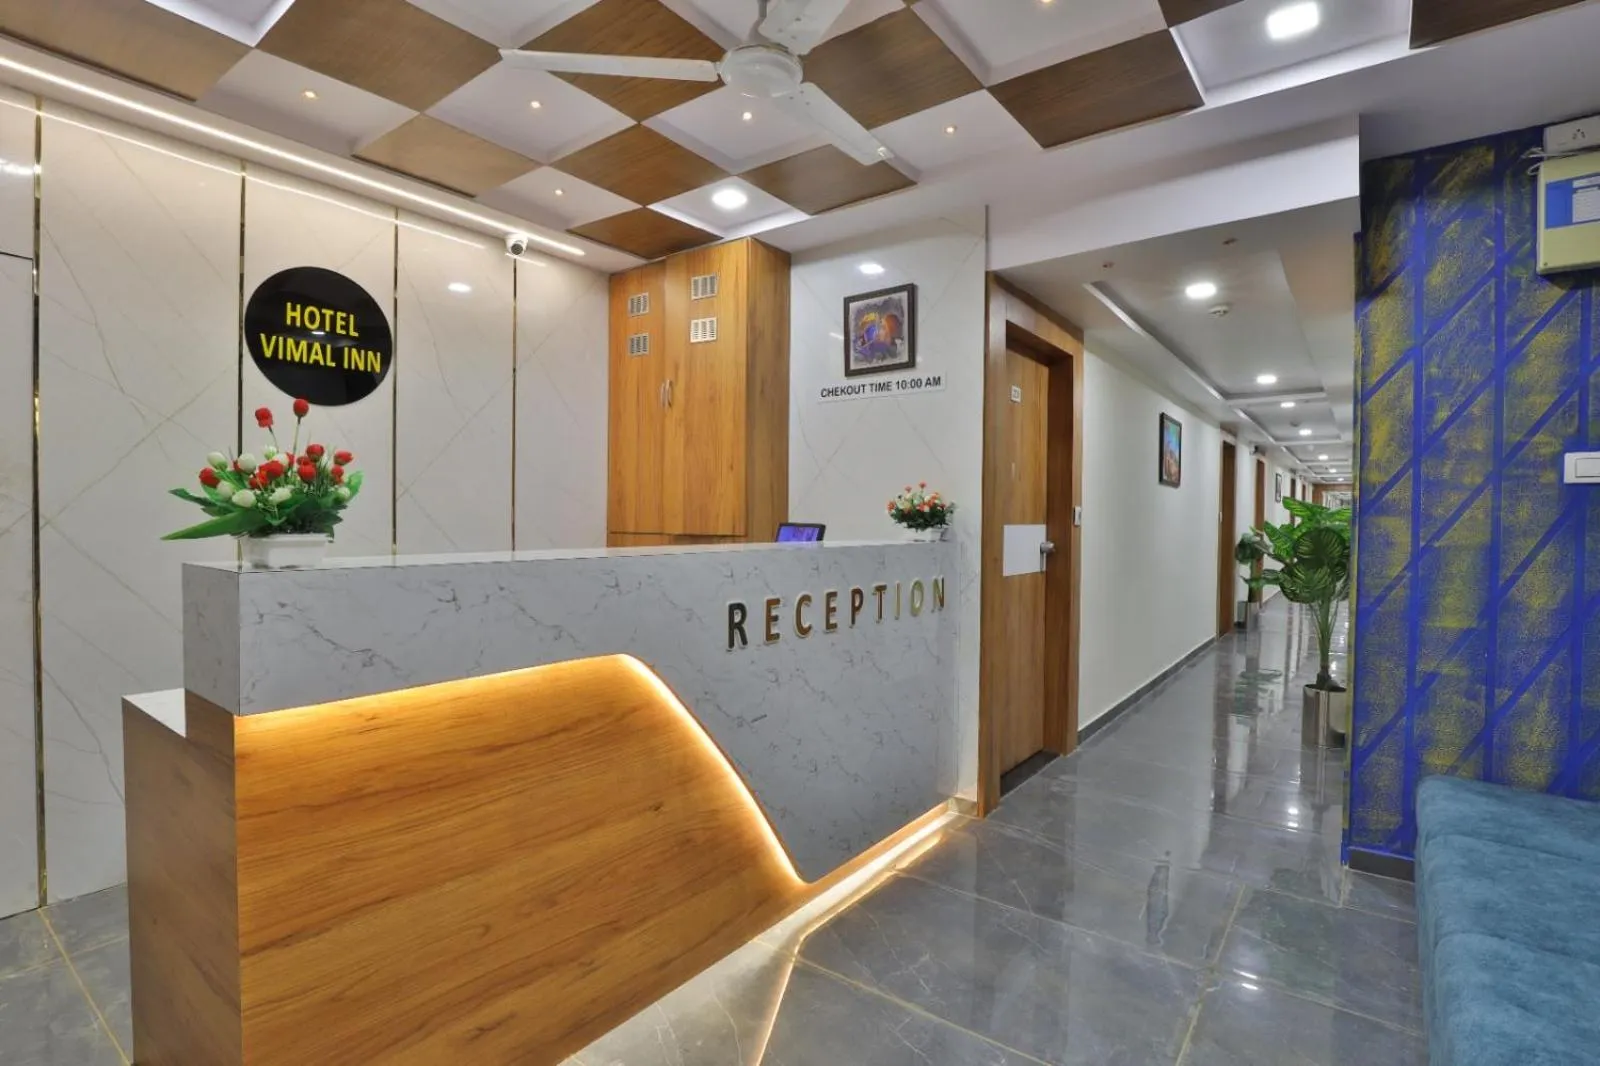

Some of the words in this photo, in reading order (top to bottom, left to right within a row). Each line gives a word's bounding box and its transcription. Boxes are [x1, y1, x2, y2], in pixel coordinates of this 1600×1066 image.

[286, 302, 359, 337] HOTEL
[260, 333, 336, 367] VIMAL
[343, 346, 381, 373] INN
[820, 383, 866, 398] CHEKOUT
[869, 381, 893, 393] TIME
[896, 378, 923, 390] 10:00
[925, 376, 942, 388] AM
[727, 577, 945, 651] RECEPTION
